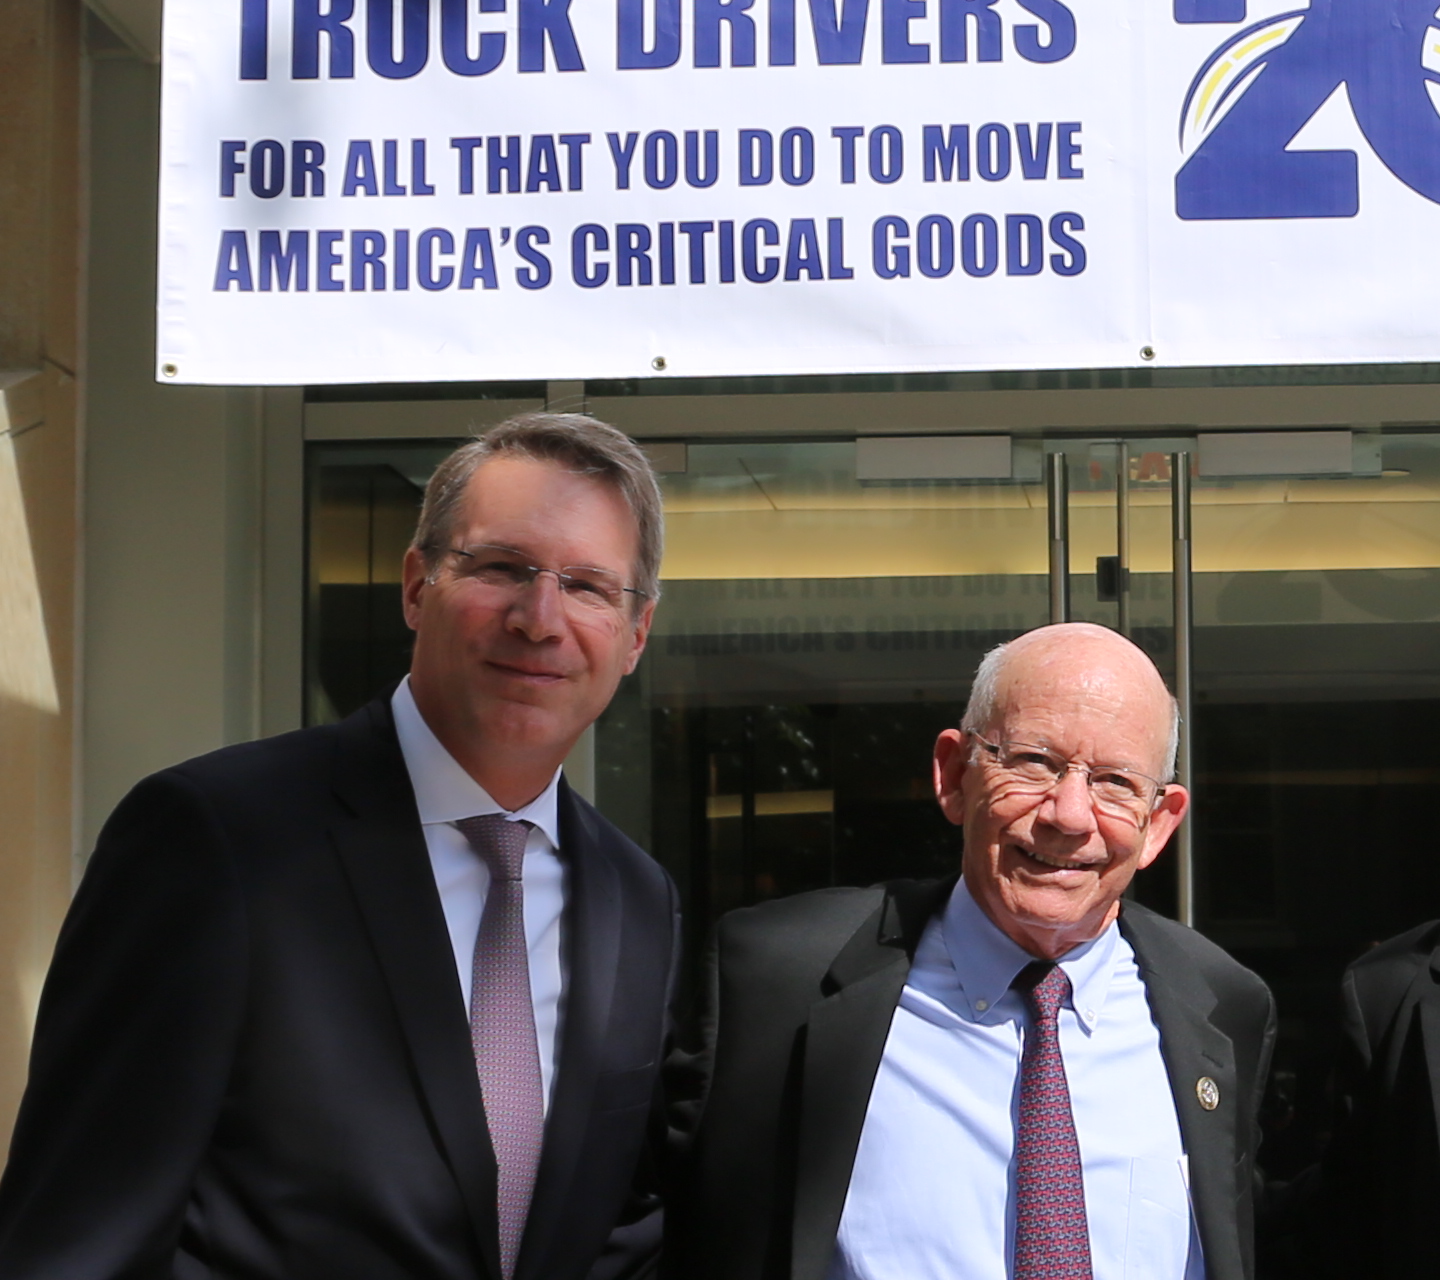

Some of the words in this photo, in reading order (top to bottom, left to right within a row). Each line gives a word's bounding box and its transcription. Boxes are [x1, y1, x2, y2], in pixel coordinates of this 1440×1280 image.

[219, 140, 326, 200] FOR
[342, 138, 435, 197] ALL
[450, 134, 590, 195] THAT
[607, 131, 719, 190] YOU
[738, 127, 815, 187] DO
[831, 125, 904, 184] TO
[922, 122, 1084, 182] MOVE
[213, 226, 552, 293] AMERICA'S
[571, 217, 854, 288] CRITICAL
[872, 211, 1088, 280] GOODS
